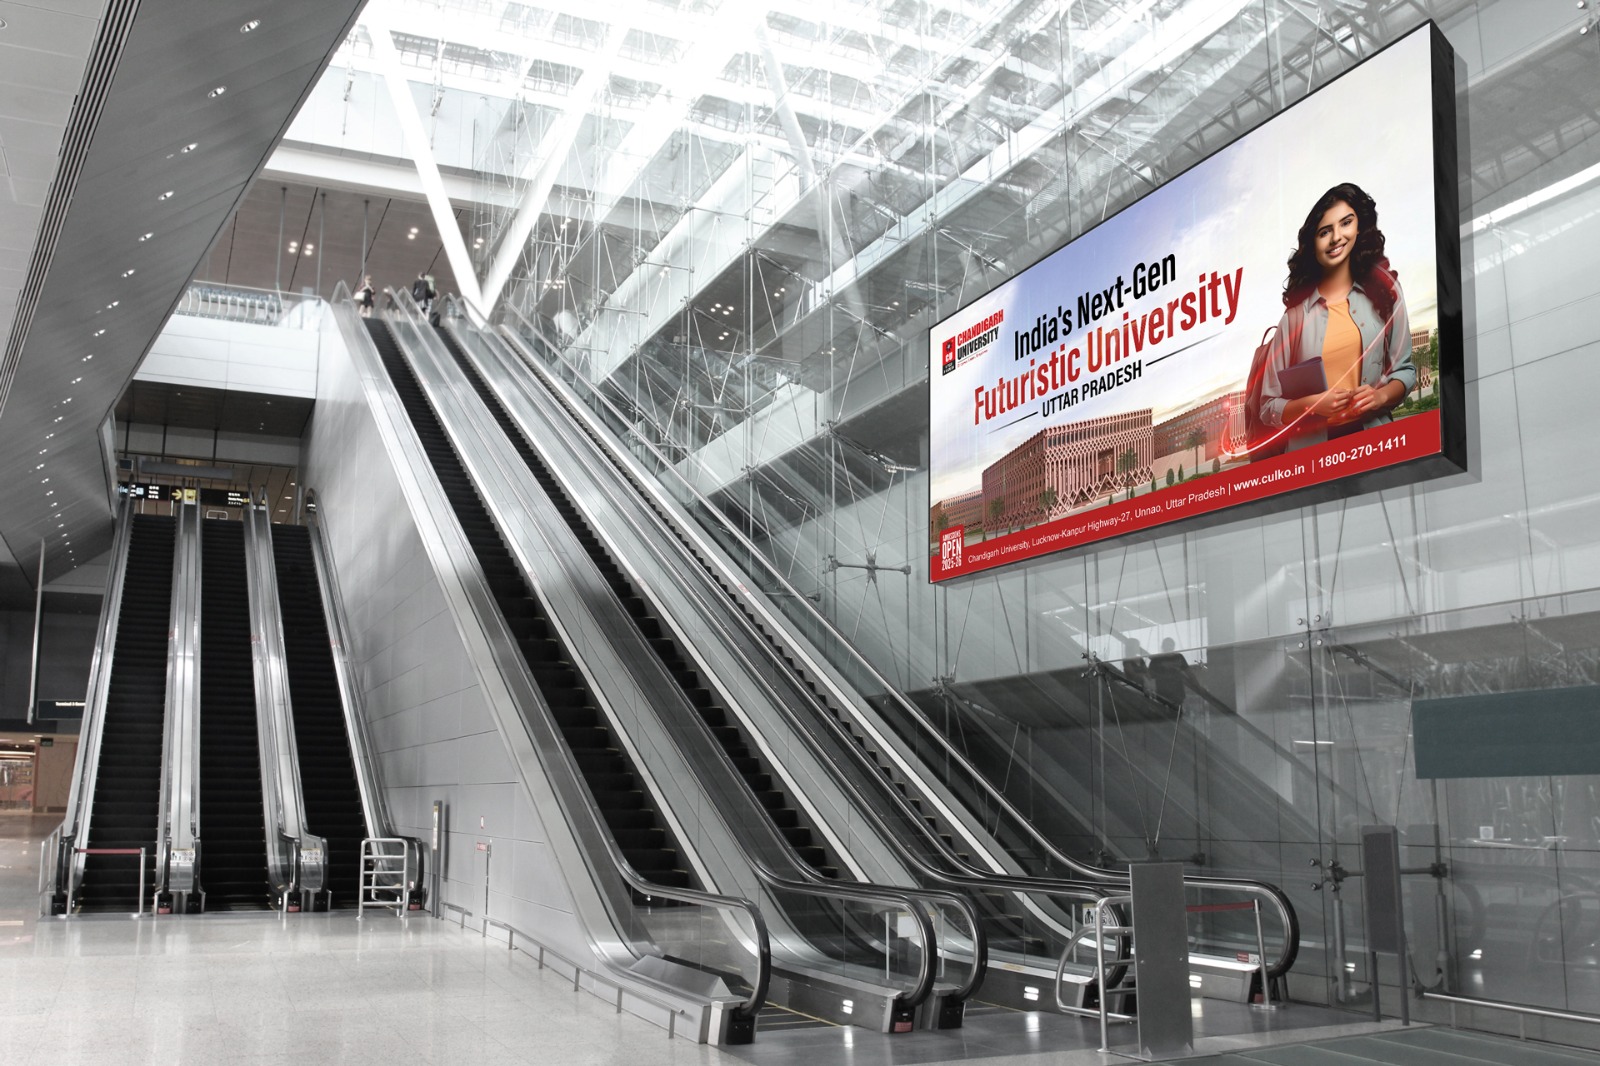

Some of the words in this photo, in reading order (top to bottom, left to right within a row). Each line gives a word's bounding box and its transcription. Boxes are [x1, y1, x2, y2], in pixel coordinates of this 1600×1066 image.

[1014, 305, 1072, 362] India's
[1077, 253, 1176, 330] Next-Gen
[957, 308, 1004, 347] CHANDIGARH
[957, 326, 1000, 361] UNIVERSITY
[974, 343, 1081, 426] Futuristic
[1087, 266, 1244, 373] University
[1041, 387, 1079, 418] UTTAR
[1081, 359, 1143, 400] PRADESH
[1318, 434, 1407, 469] 1800-270-1411
[1233, 463, 1305, 492] www.culko.in
[967, 548, 1000, 564] Chandigarh
[1031, 524, 1087, 547] Lucknow-Kanpur
[1165, 496, 1187, 511] Uttar
[1188, 487, 1226, 504] Pradesh
[941, 537, 962, 560] OPEN
